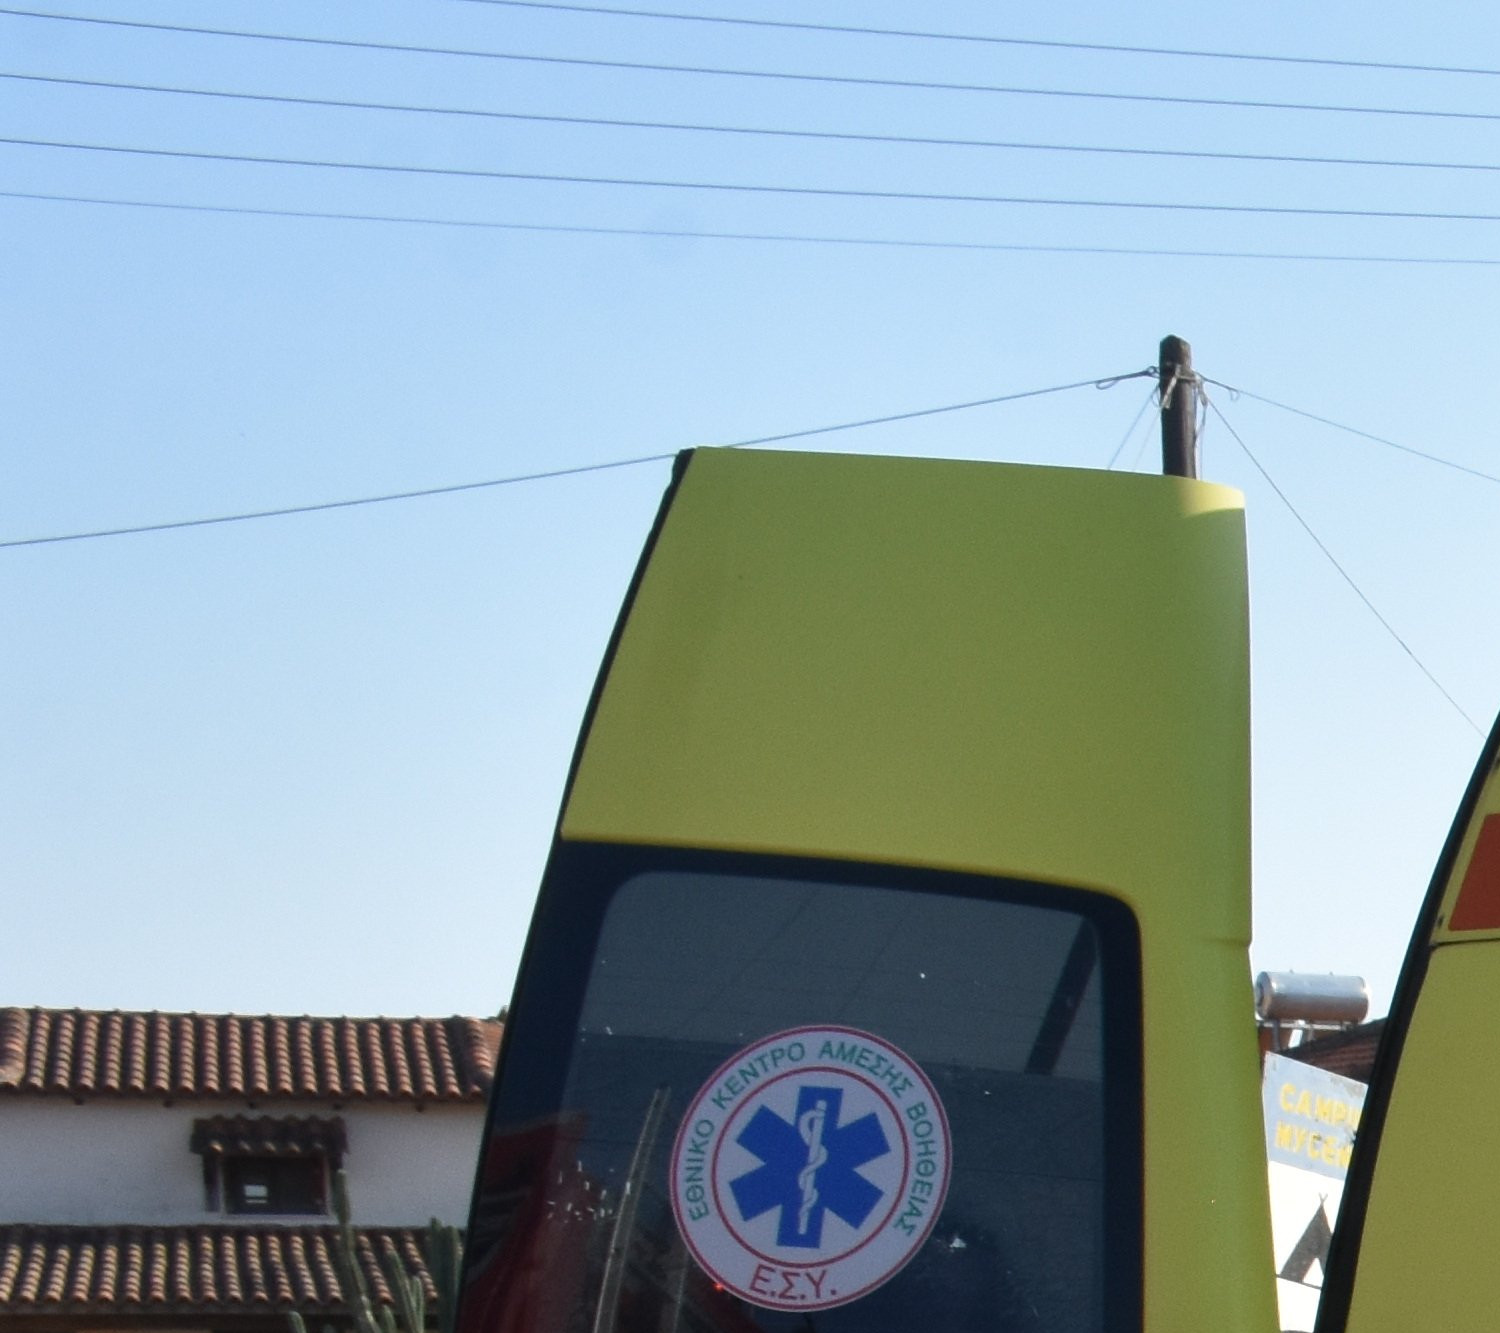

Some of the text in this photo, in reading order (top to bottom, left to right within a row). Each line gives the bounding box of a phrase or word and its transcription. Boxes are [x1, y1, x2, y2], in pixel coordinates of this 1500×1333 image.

[685, 1039, 937, 1237] ΕΘΝΙΚΟ ΚΕΝΤΡΟ ΑΜΕΣΗΣ ΒΟΗΘΕΙΑΣ
